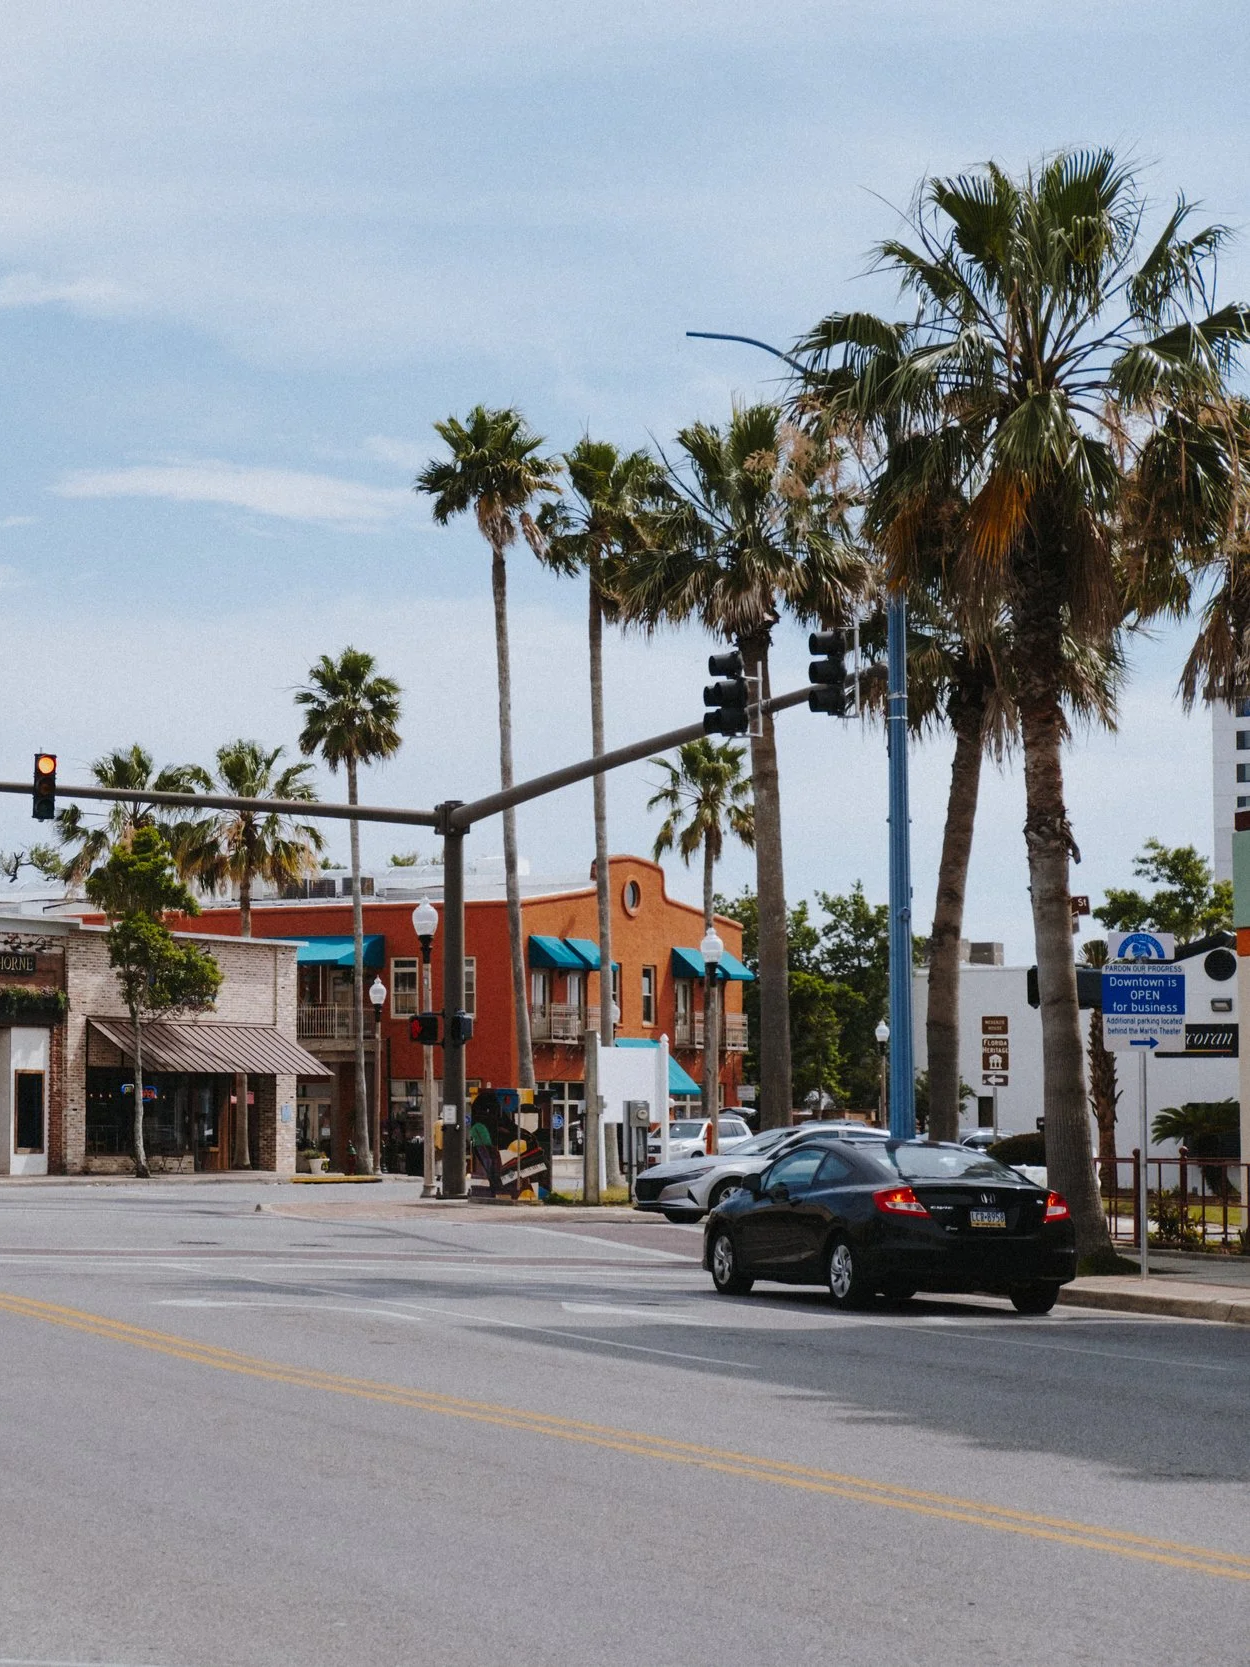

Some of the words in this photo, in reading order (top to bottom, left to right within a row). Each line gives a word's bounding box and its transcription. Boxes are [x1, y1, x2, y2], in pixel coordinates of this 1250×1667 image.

[1078, 898, 1087, 907] St
[1148, 965, 1182, 973] PROGRESS
[1109, 976, 1164, 987] Downtown
[1168, 978, 1177, 987] is
[1130, 990, 1160, 1000] OPEN
[1113, 1002, 1127, 1012] for
[1131, 1002, 1178, 1012] business
[1106, 1017, 1135, 1025] Additional
[1137, 1018, 1159, 1026] parking
[1161, 1017, 1183, 1025] located
[1160, 1027, 1181, 1035] Theater
[1185, 1032, 1233, 1045] coran
